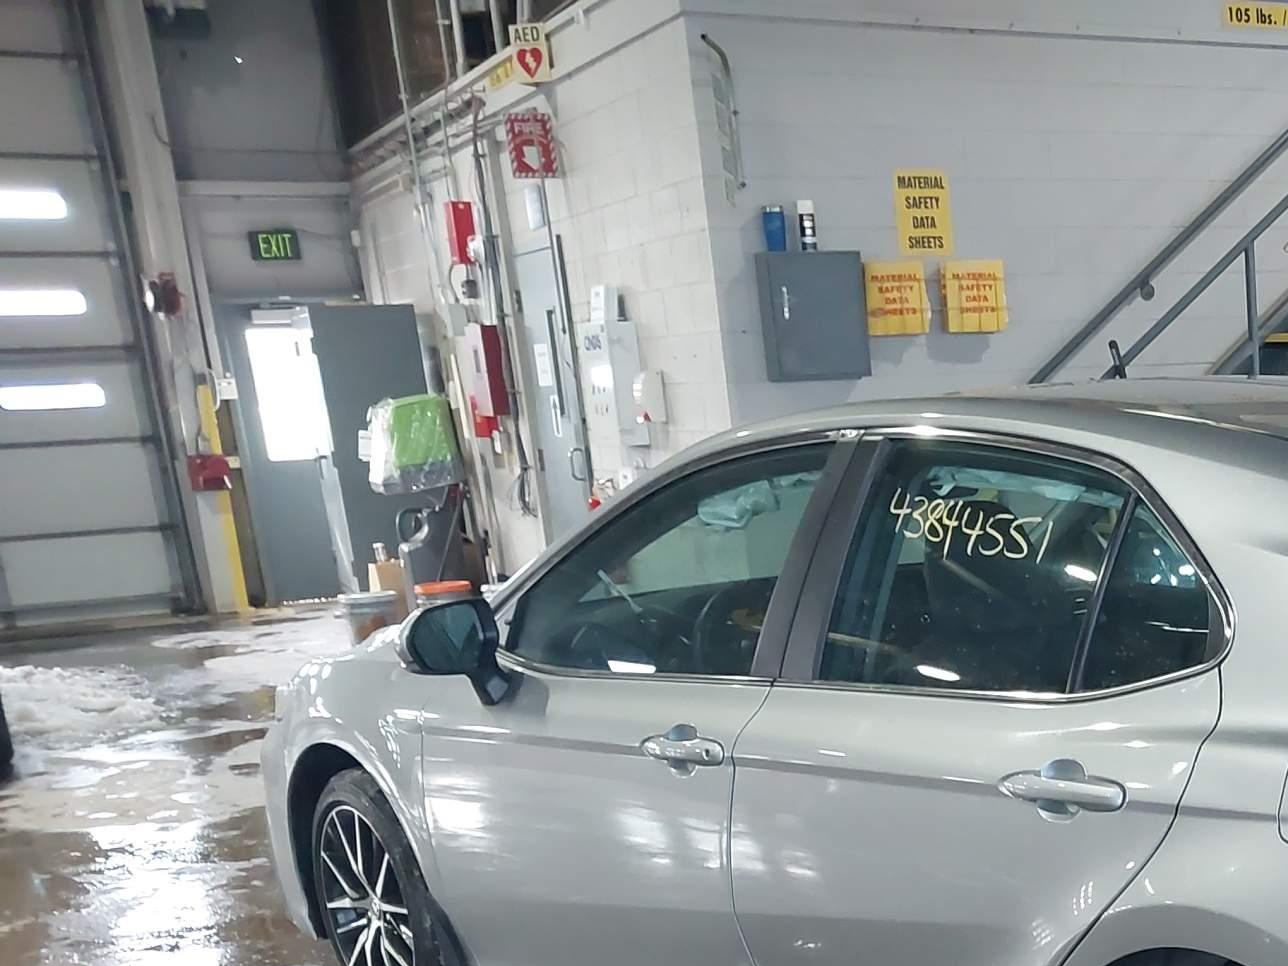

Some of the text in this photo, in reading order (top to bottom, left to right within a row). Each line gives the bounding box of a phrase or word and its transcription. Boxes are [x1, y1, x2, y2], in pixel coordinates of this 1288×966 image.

[1228, 7, 1250, 23] 105
[1256, 8, 1277, 25] lbs.
[514, 26, 540, 42] AED
[514, 122, 545, 135] FIRE
[897, 175, 944, 190] MATERIAL
[905, 196, 940, 209] SAFETY
[912, 216, 936, 229] DATA
[258, 233, 292, 257] EXIT
[908, 235, 944, 249] SHEETS
[870, 273, 919, 282] MATERIAL
[952, 272, 999, 281] MATERIAL
[878, 285, 914, 294] SAFETY
[959, 283, 993, 292] SAFETY
[885, 296, 909, 305] DATA
[965, 293, 989, 302] DATA
[890, 488, 1053, 564] 43844551
